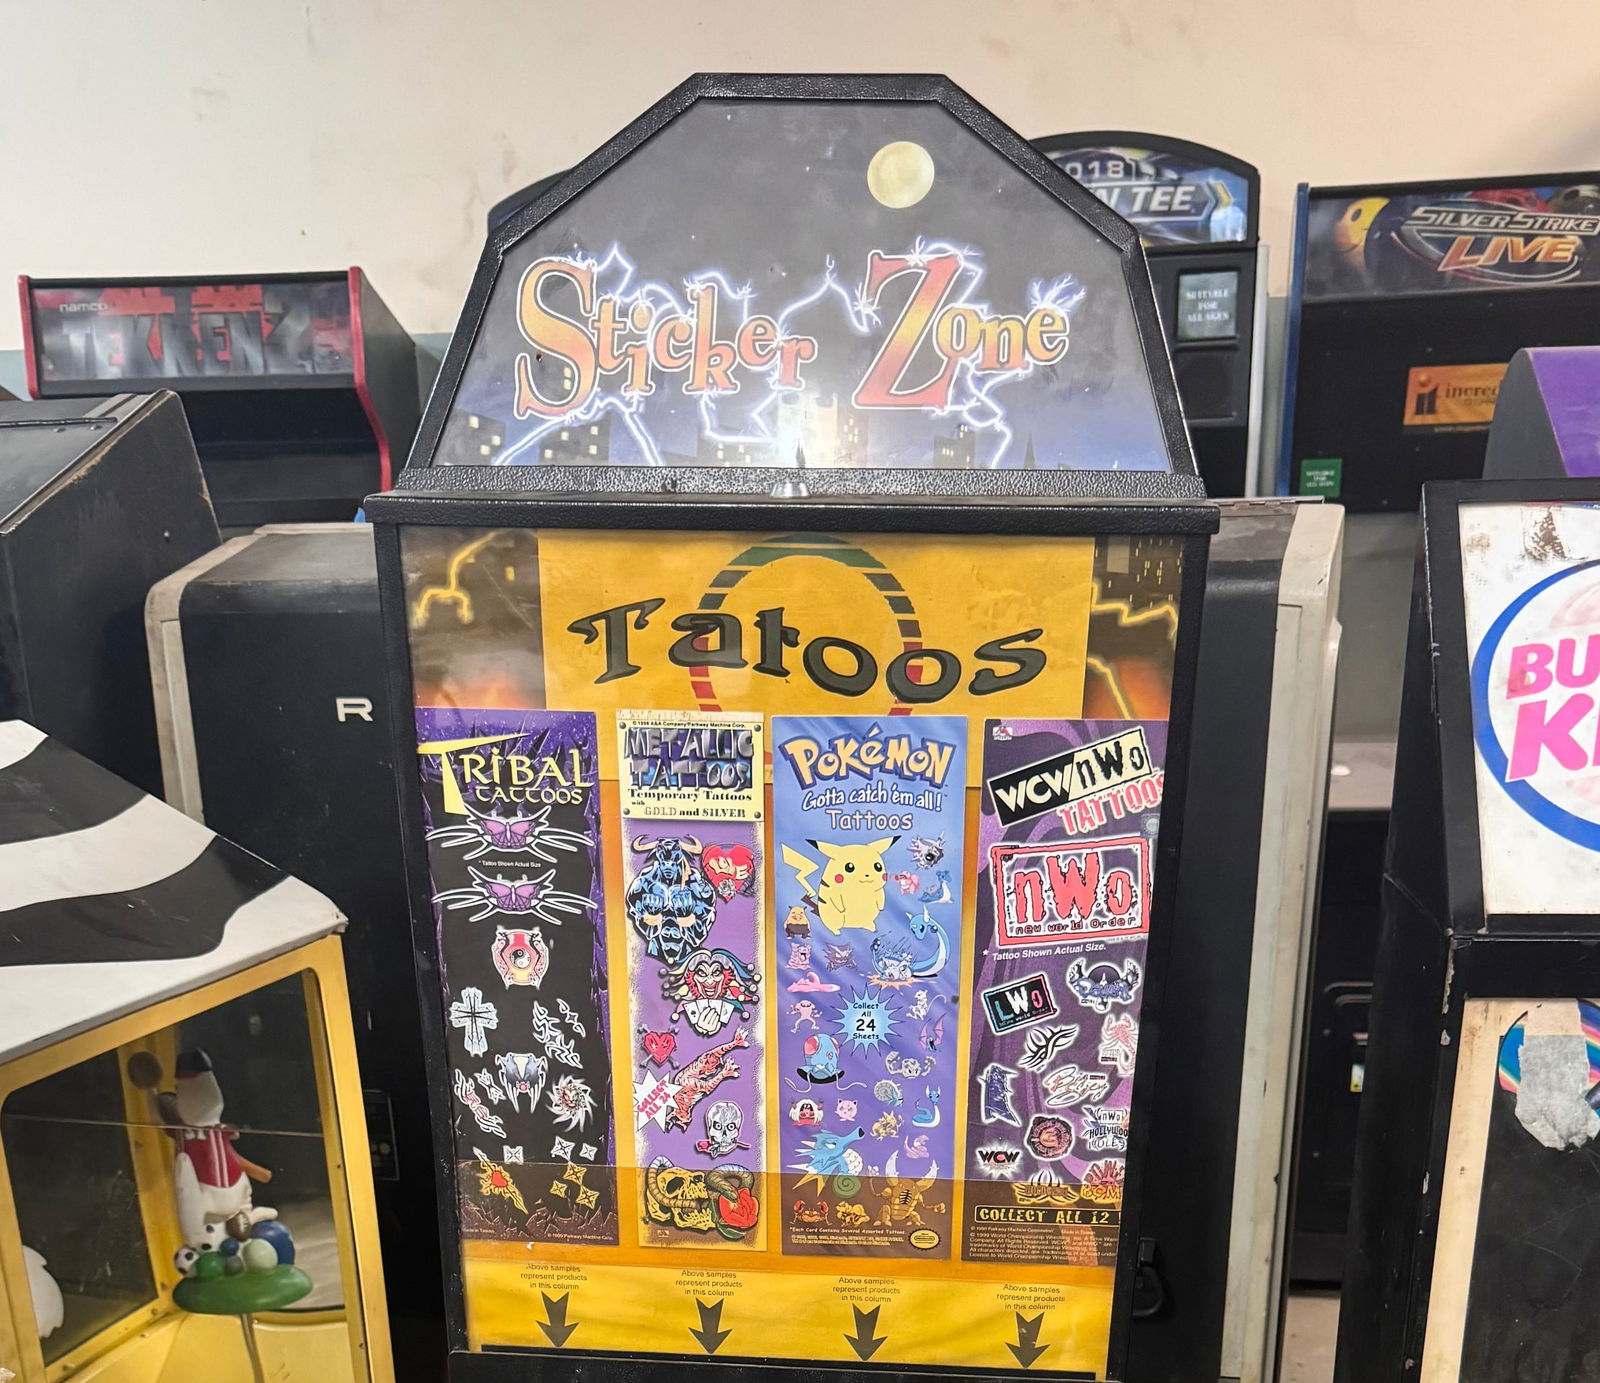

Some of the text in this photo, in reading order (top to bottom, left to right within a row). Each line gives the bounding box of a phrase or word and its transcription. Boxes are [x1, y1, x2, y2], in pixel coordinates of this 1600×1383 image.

[1062, 161, 1124, 178] 018
[1132, 186, 1195, 212] TEE
[1407, 206, 1599, 232] SILVER STRIKE
[1438, 236, 1581, 271] LIVE
[60, 301, 108, 313] namco
[515, 250, 1069, 419] Sticker Zone
[567, 597, 1047, 703] Tatoos
[336, 698, 373, 722] R
[624, 728, 754, 759] METALLIC
[630, 758, 752, 791] TATTOOS
[627, 789, 752, 802] Temporary Tattoos
[802, 787, 845, 811] Gotta
[849, 780, 887, 803] catch
[644, 806, 746, 818] GOLD and SILVER
[825, 809, 913, 830] Tattoos
[1014, 851, 1132, 923] nWo
[1016, 924, 1041, 935] new
[1047, 920, 1083, 932] world
[992, 943, 1107, 961] Tattoo Shown Actual Size.
[856, 1018, 876, 1032] 24
[637, 1080, 668, 1112] COLLECT
[646, 1103, 662, 1119] ALL
[978, 1150, 1020, 1163] WCW
[980, 1209, 1110, 1224] COLLECT ALL 12
[521, 1272, 554, 1280] represent
[1003, 1283, 1060, 1294] Above samples
